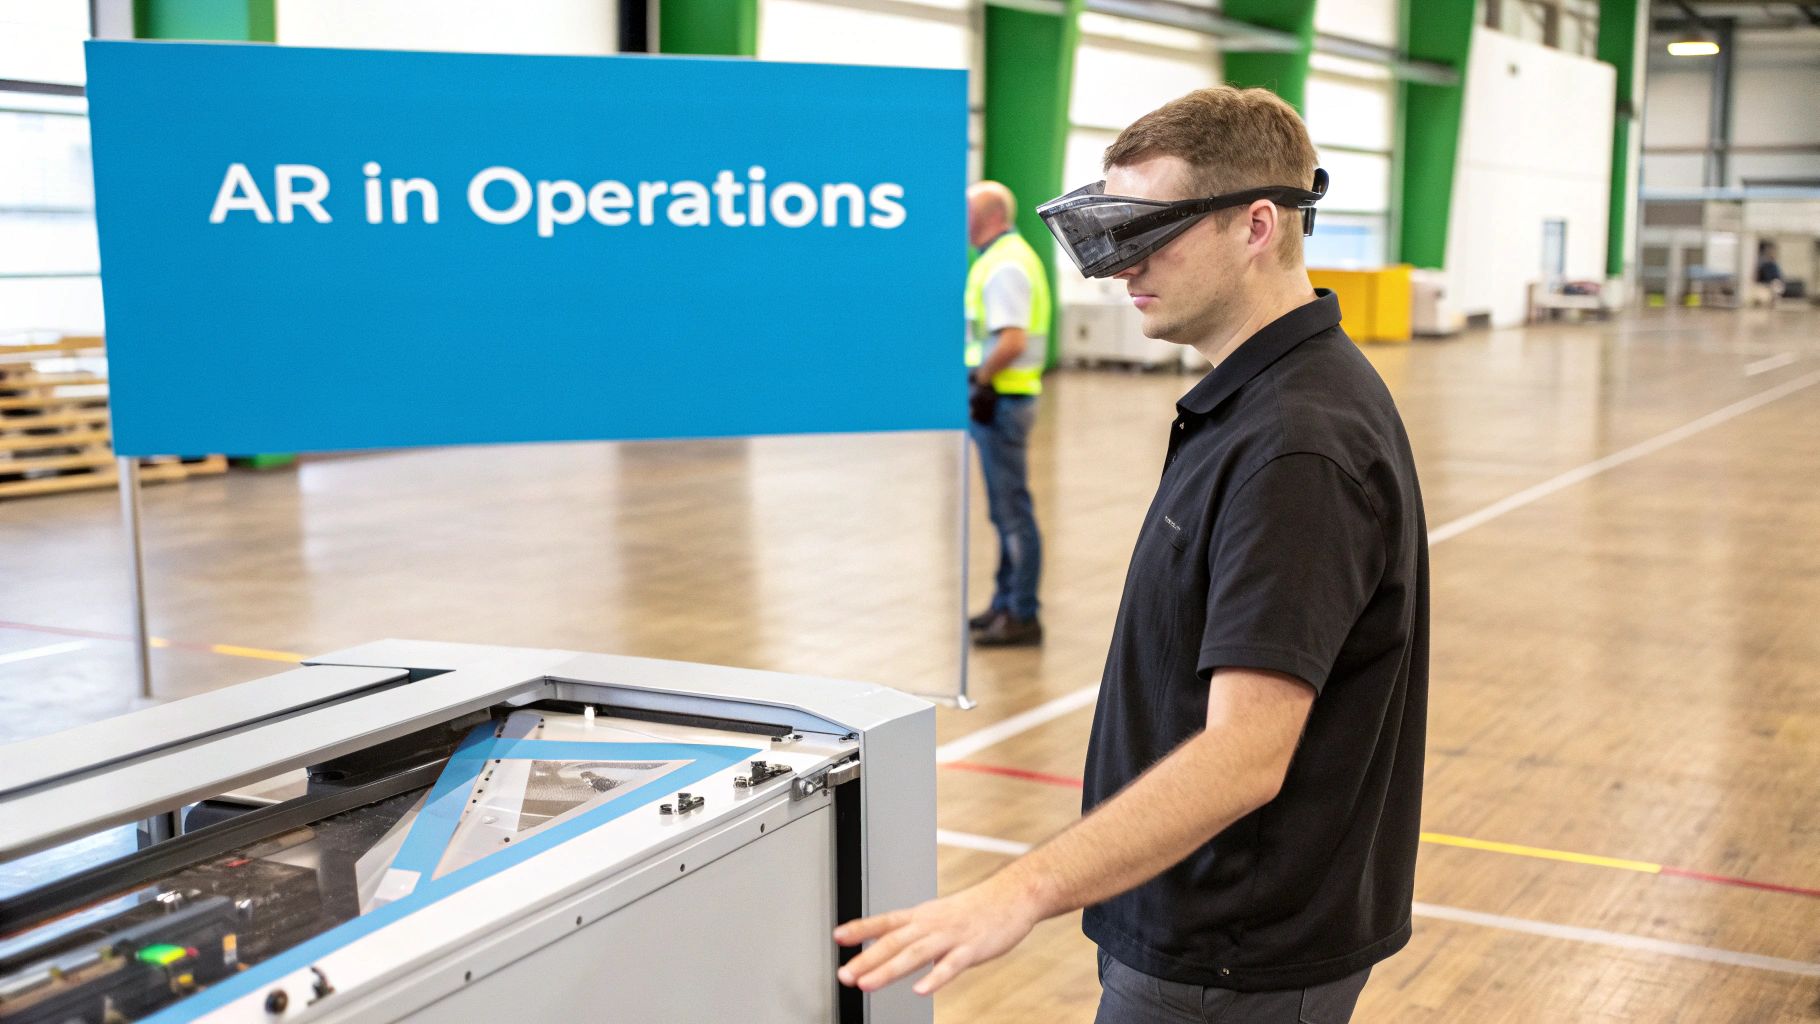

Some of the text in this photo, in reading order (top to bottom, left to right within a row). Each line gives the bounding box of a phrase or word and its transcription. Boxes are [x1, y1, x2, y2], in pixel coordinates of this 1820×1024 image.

[210, 161, 906, 238] AR in Operations
